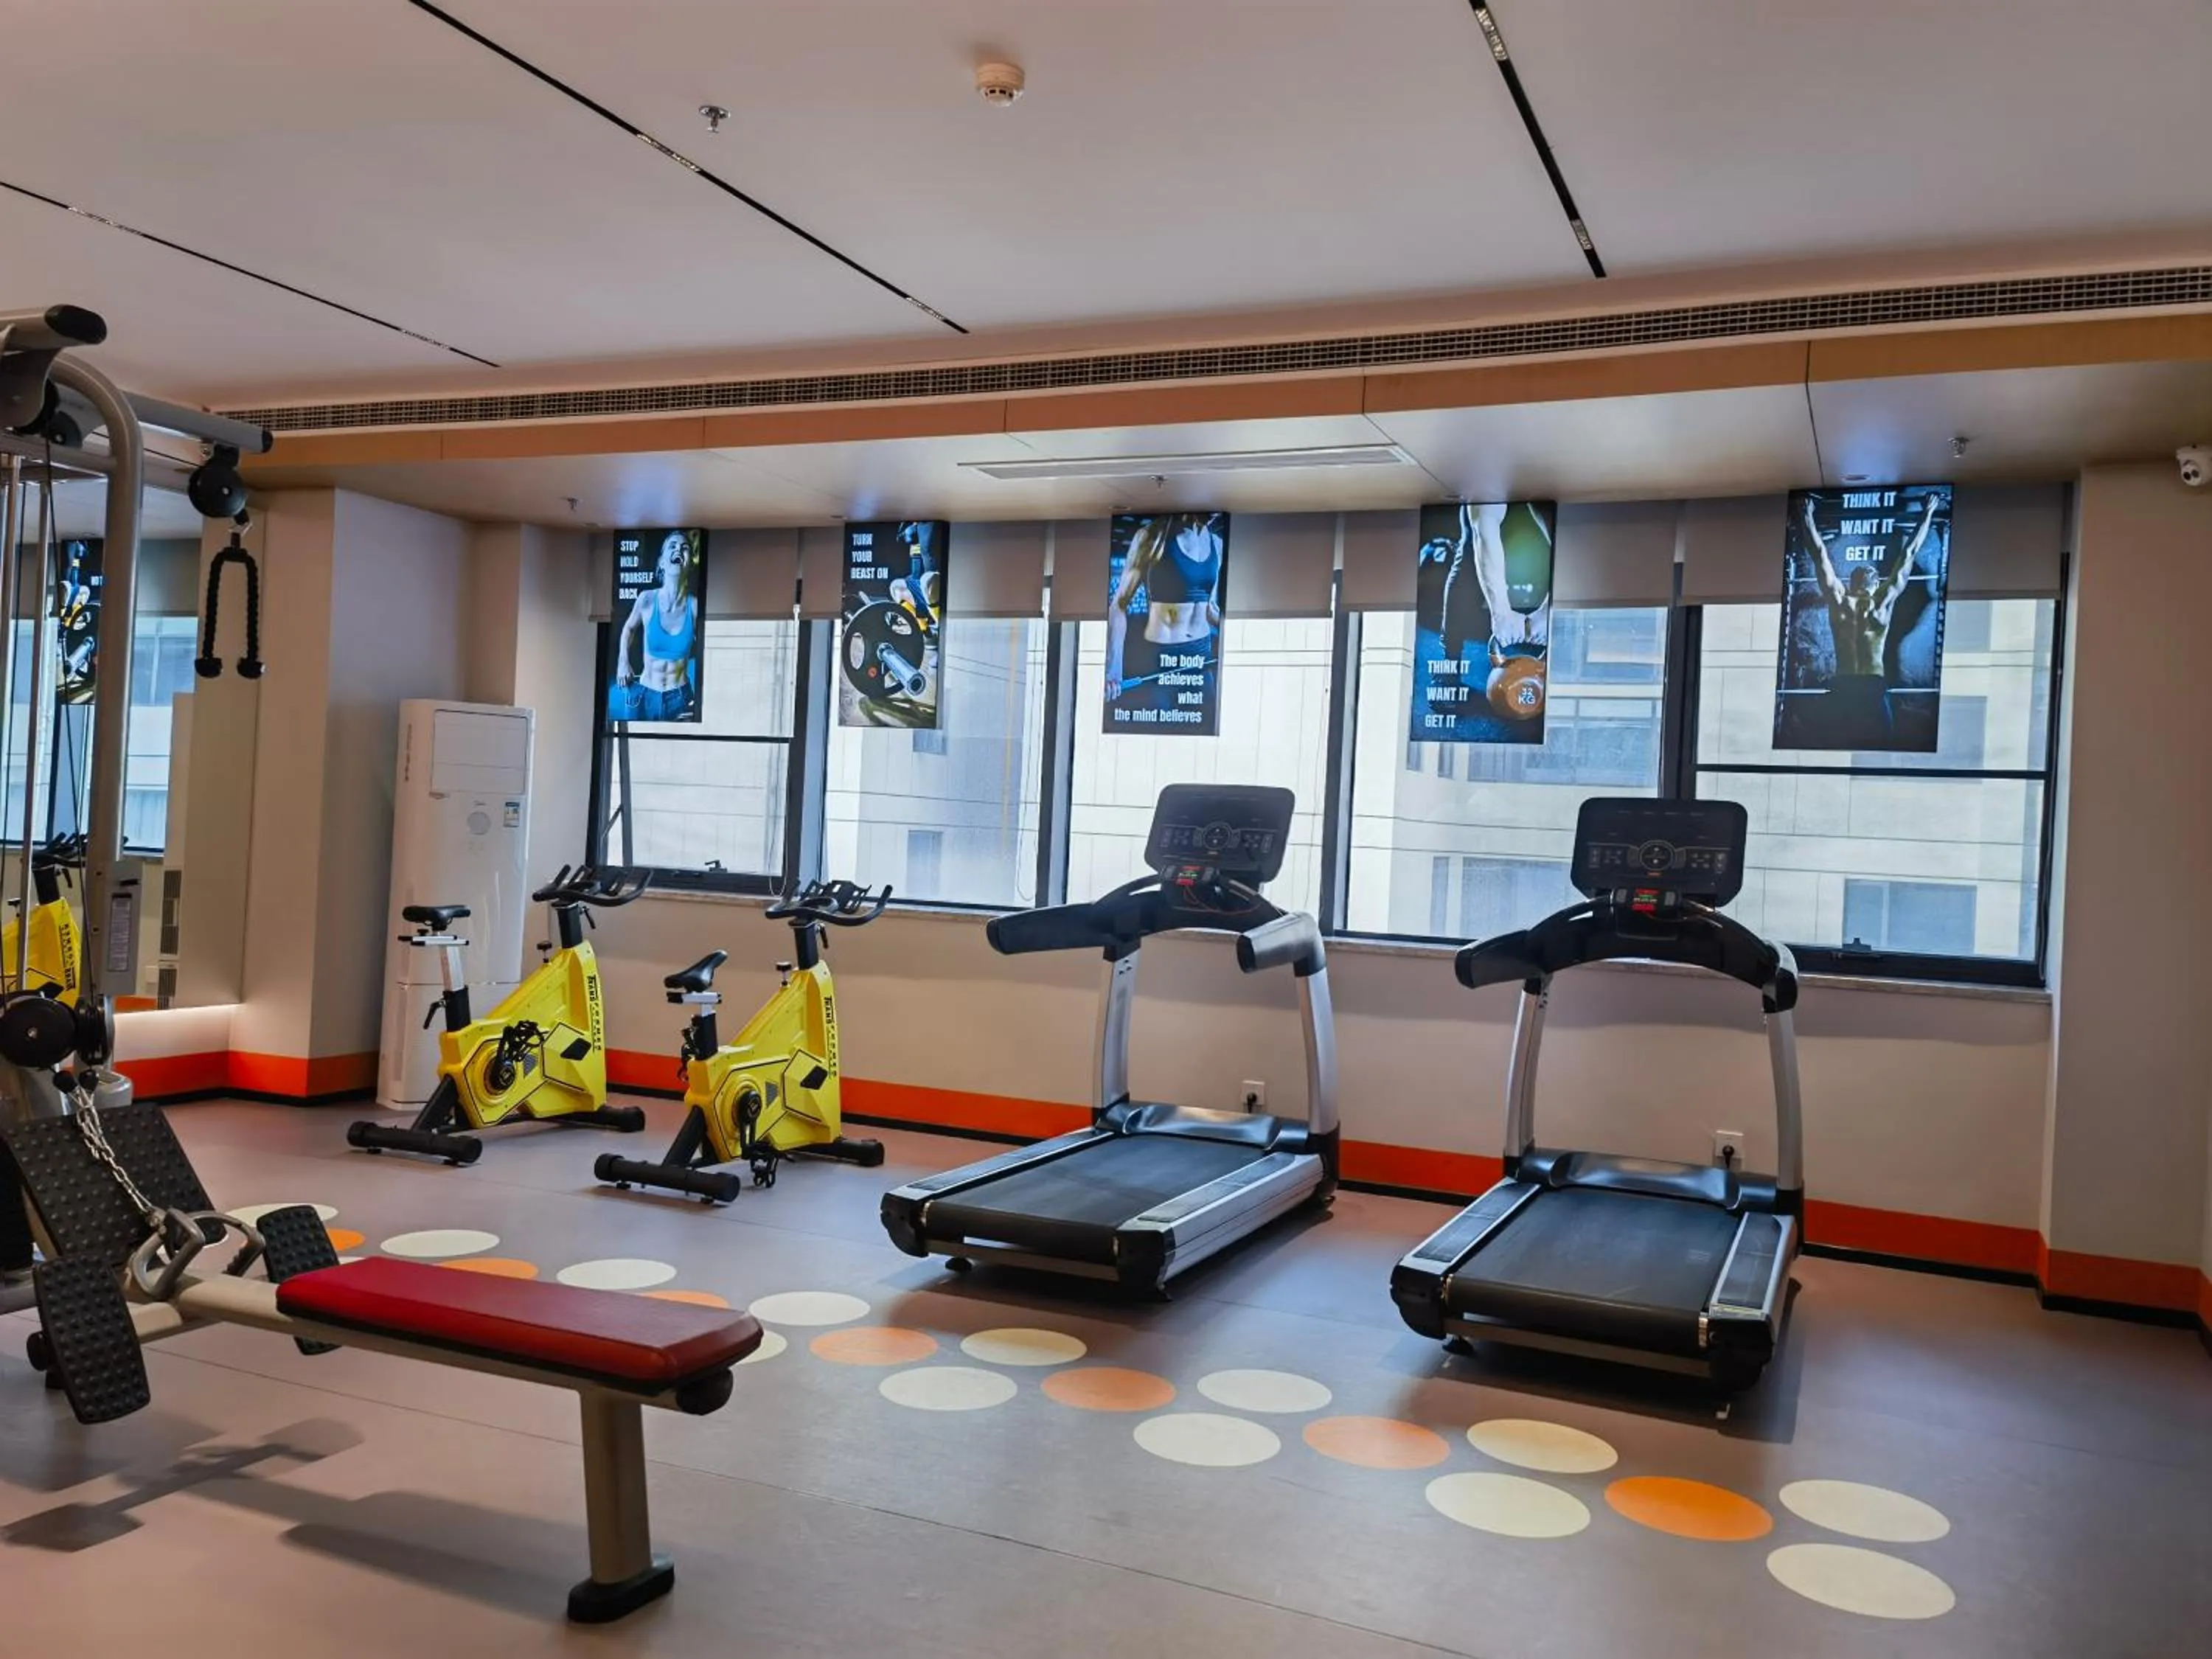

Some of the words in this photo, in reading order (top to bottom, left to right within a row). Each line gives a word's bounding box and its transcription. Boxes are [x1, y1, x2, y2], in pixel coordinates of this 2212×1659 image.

[1843, 493, 1880, 508] THINK
[1884, 491, 1896, 507] IT
[1840, 519, 1879, 535] WANT
[1882, 518, 1895, 534] IT
[620, 540, 639, 552] STOP
[852, 533, 873, 546] TURN
[852, 551, 872, 563] YOUR
[1846, 546, 1870, 561] GET
[1873, 546, 1886, 560] IT
[620, 571, 653, 583] YOURSELF
[851, 567, 875, 579] BEAST
[877, 567, 888, 579] ON
[1160, 654, 1177, 667] The
[1180, 654, 1206, 669] body
[1427, 660, 1458, 674] THINK
[1460, 660, 1471, 673] IT
[1158, 672, 1204, 686] achieves
[1178, 692, 1203, 704] what
[1427, 686, 1455, 701] WANT
[1458, 686, 1470, 701] IT
[1114, 708, 1130, 720] the
[1133, 709, 1158, 722] mind
[1159, 709, 1203, 723] believes
[1425, 714, 1444, 728] GET
[1446, 715, 1456, 728] IT
